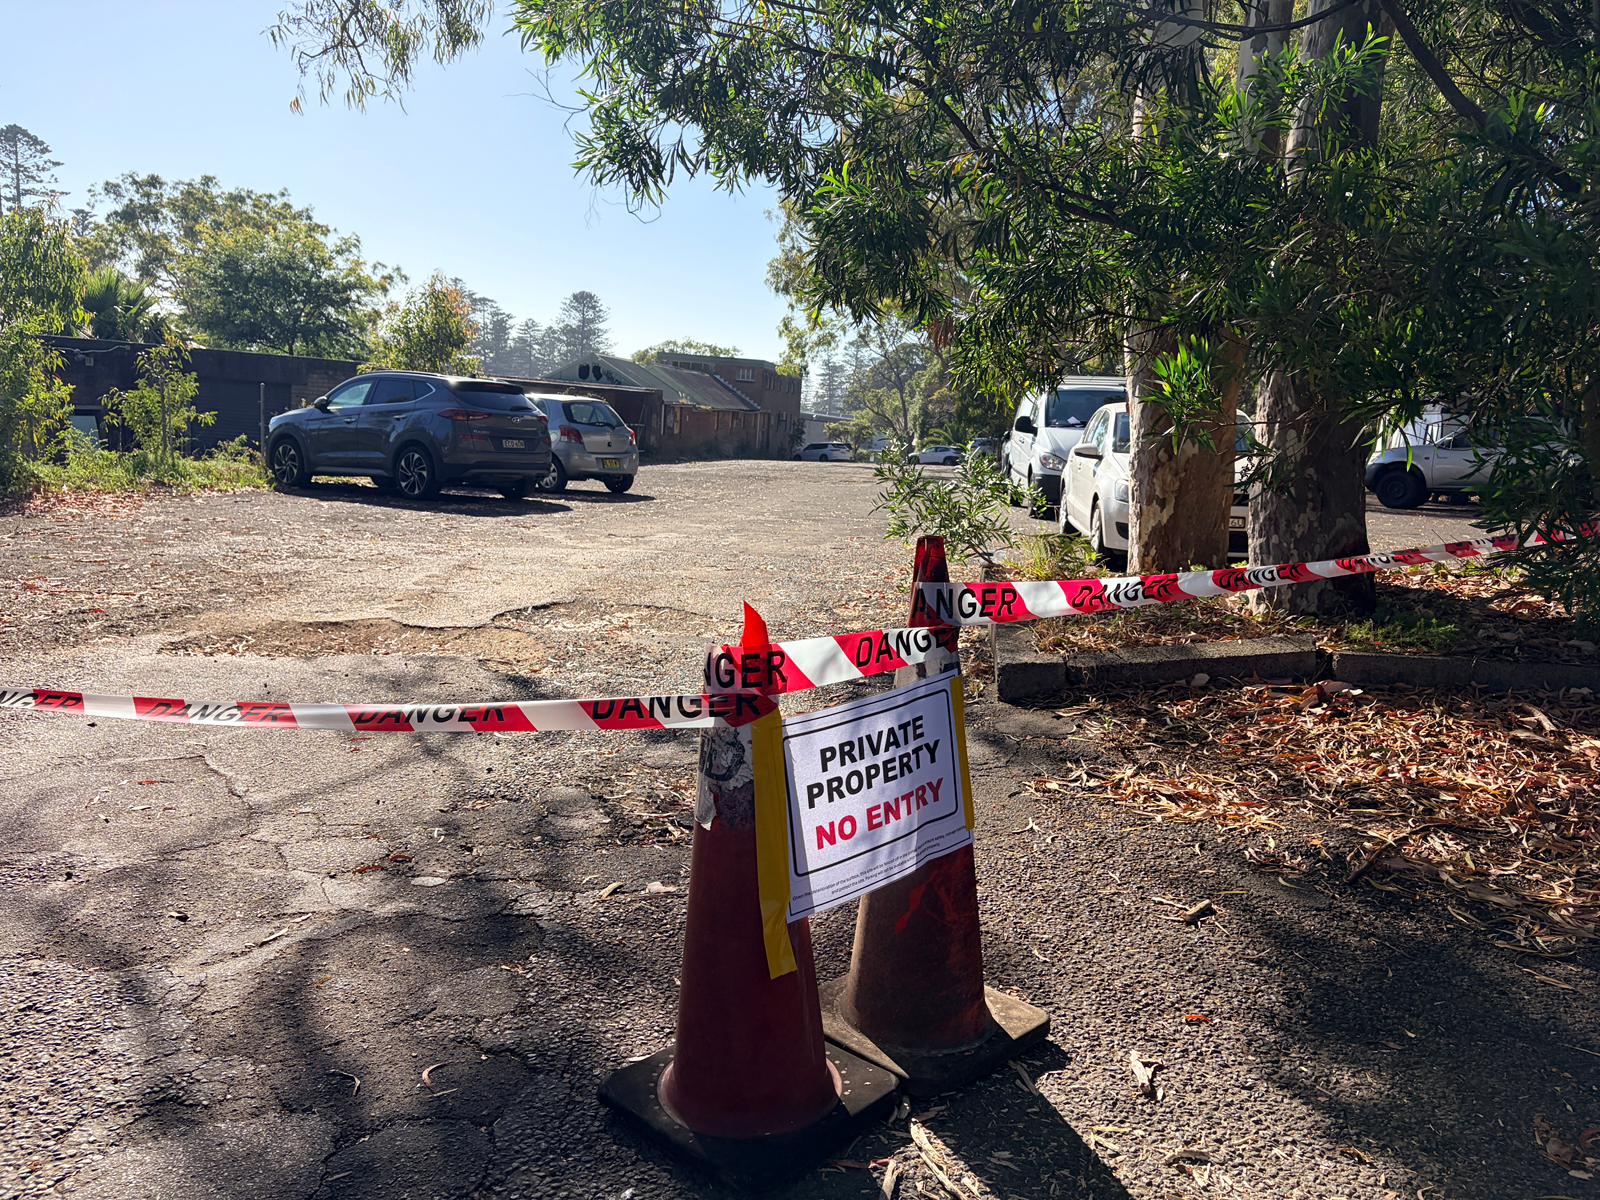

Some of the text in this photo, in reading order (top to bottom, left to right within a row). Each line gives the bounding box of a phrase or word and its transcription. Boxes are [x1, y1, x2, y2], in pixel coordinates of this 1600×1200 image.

[911, 588, 1017, 619] ANGER
[1072, 578, 1178, 608] DANGER
[1220, 565, 1303, 588] DANGER
[703, 629, 950, 689] NGER DANGE
[0, 691, 761, 724] NGER DANGER DANGER DANGER
[819, 715, 924, 773] PRIVATE
[806, 738, 940, 810] PROPERTY
[815, 814, 857, 850] NO
[866, 777, 944, 831] ENTRY
